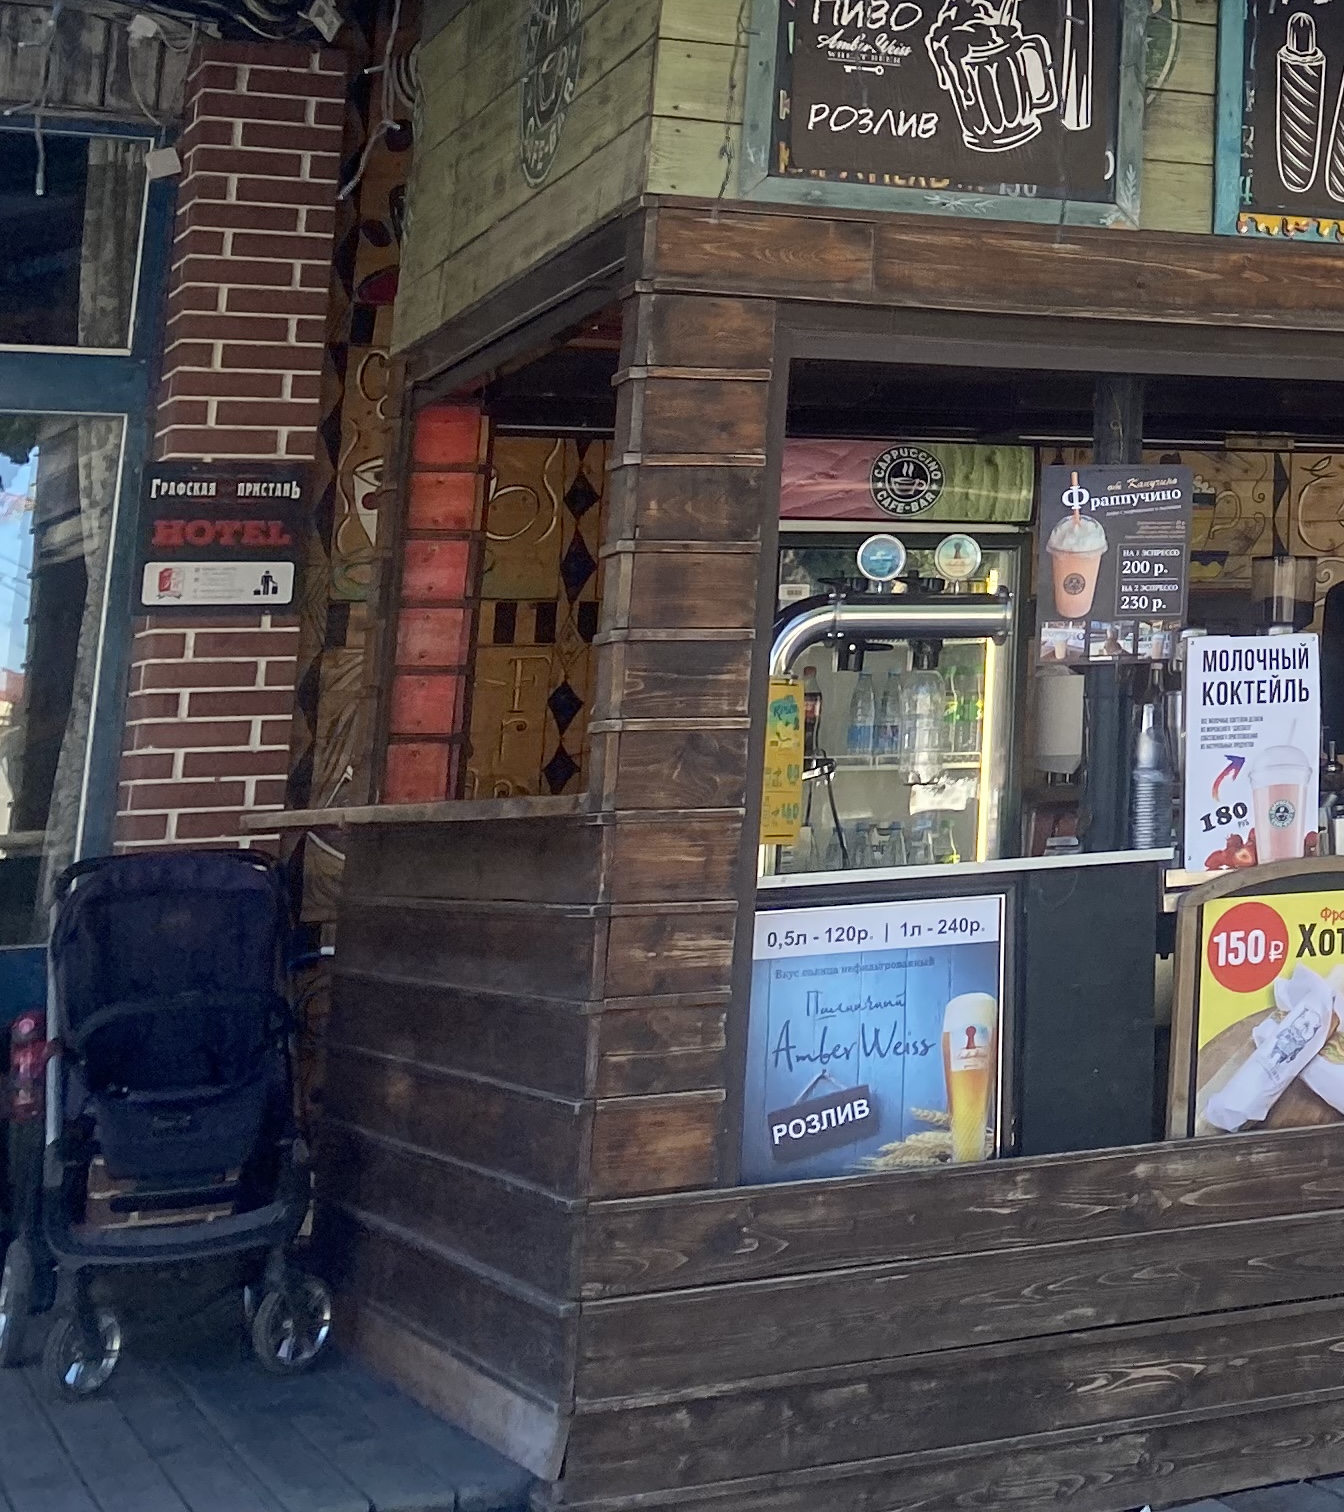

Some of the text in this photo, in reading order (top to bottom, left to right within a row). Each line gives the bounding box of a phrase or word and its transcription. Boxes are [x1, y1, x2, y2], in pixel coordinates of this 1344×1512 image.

[807, 104, 939, 139] РОЗЛИВ
[874, 447, 942, 480] CAPPUCCINO
[877, 491, 936, 513] CAFE-BAR
[1061, 485, 1182, 511] Фраппучино
[152, 519, 292, 546] HOTEL
[1122, 561, 1168, 576] 200 р.
[1120, 595, 1167, 612] 230 р.
[1202, 643, 1309, 673] МОЛОЧНЫЙ
[1202, 675, 1310, 706] КОКТЕЙЛЬ
[1200, 802, 1248, 832] 180
[767, 931, 807, 949] 0,5л
[825, 926, 874, 944] 120р.
[900, 922, 922, 938] 1л
[938, 918, 985, 936] 240р.
[775, 968, 800, 980] Вкус
[772, 1019, 936, 1072] Amber Weiss
[772, 1098, 871, 1144] РОЗЛИВ
